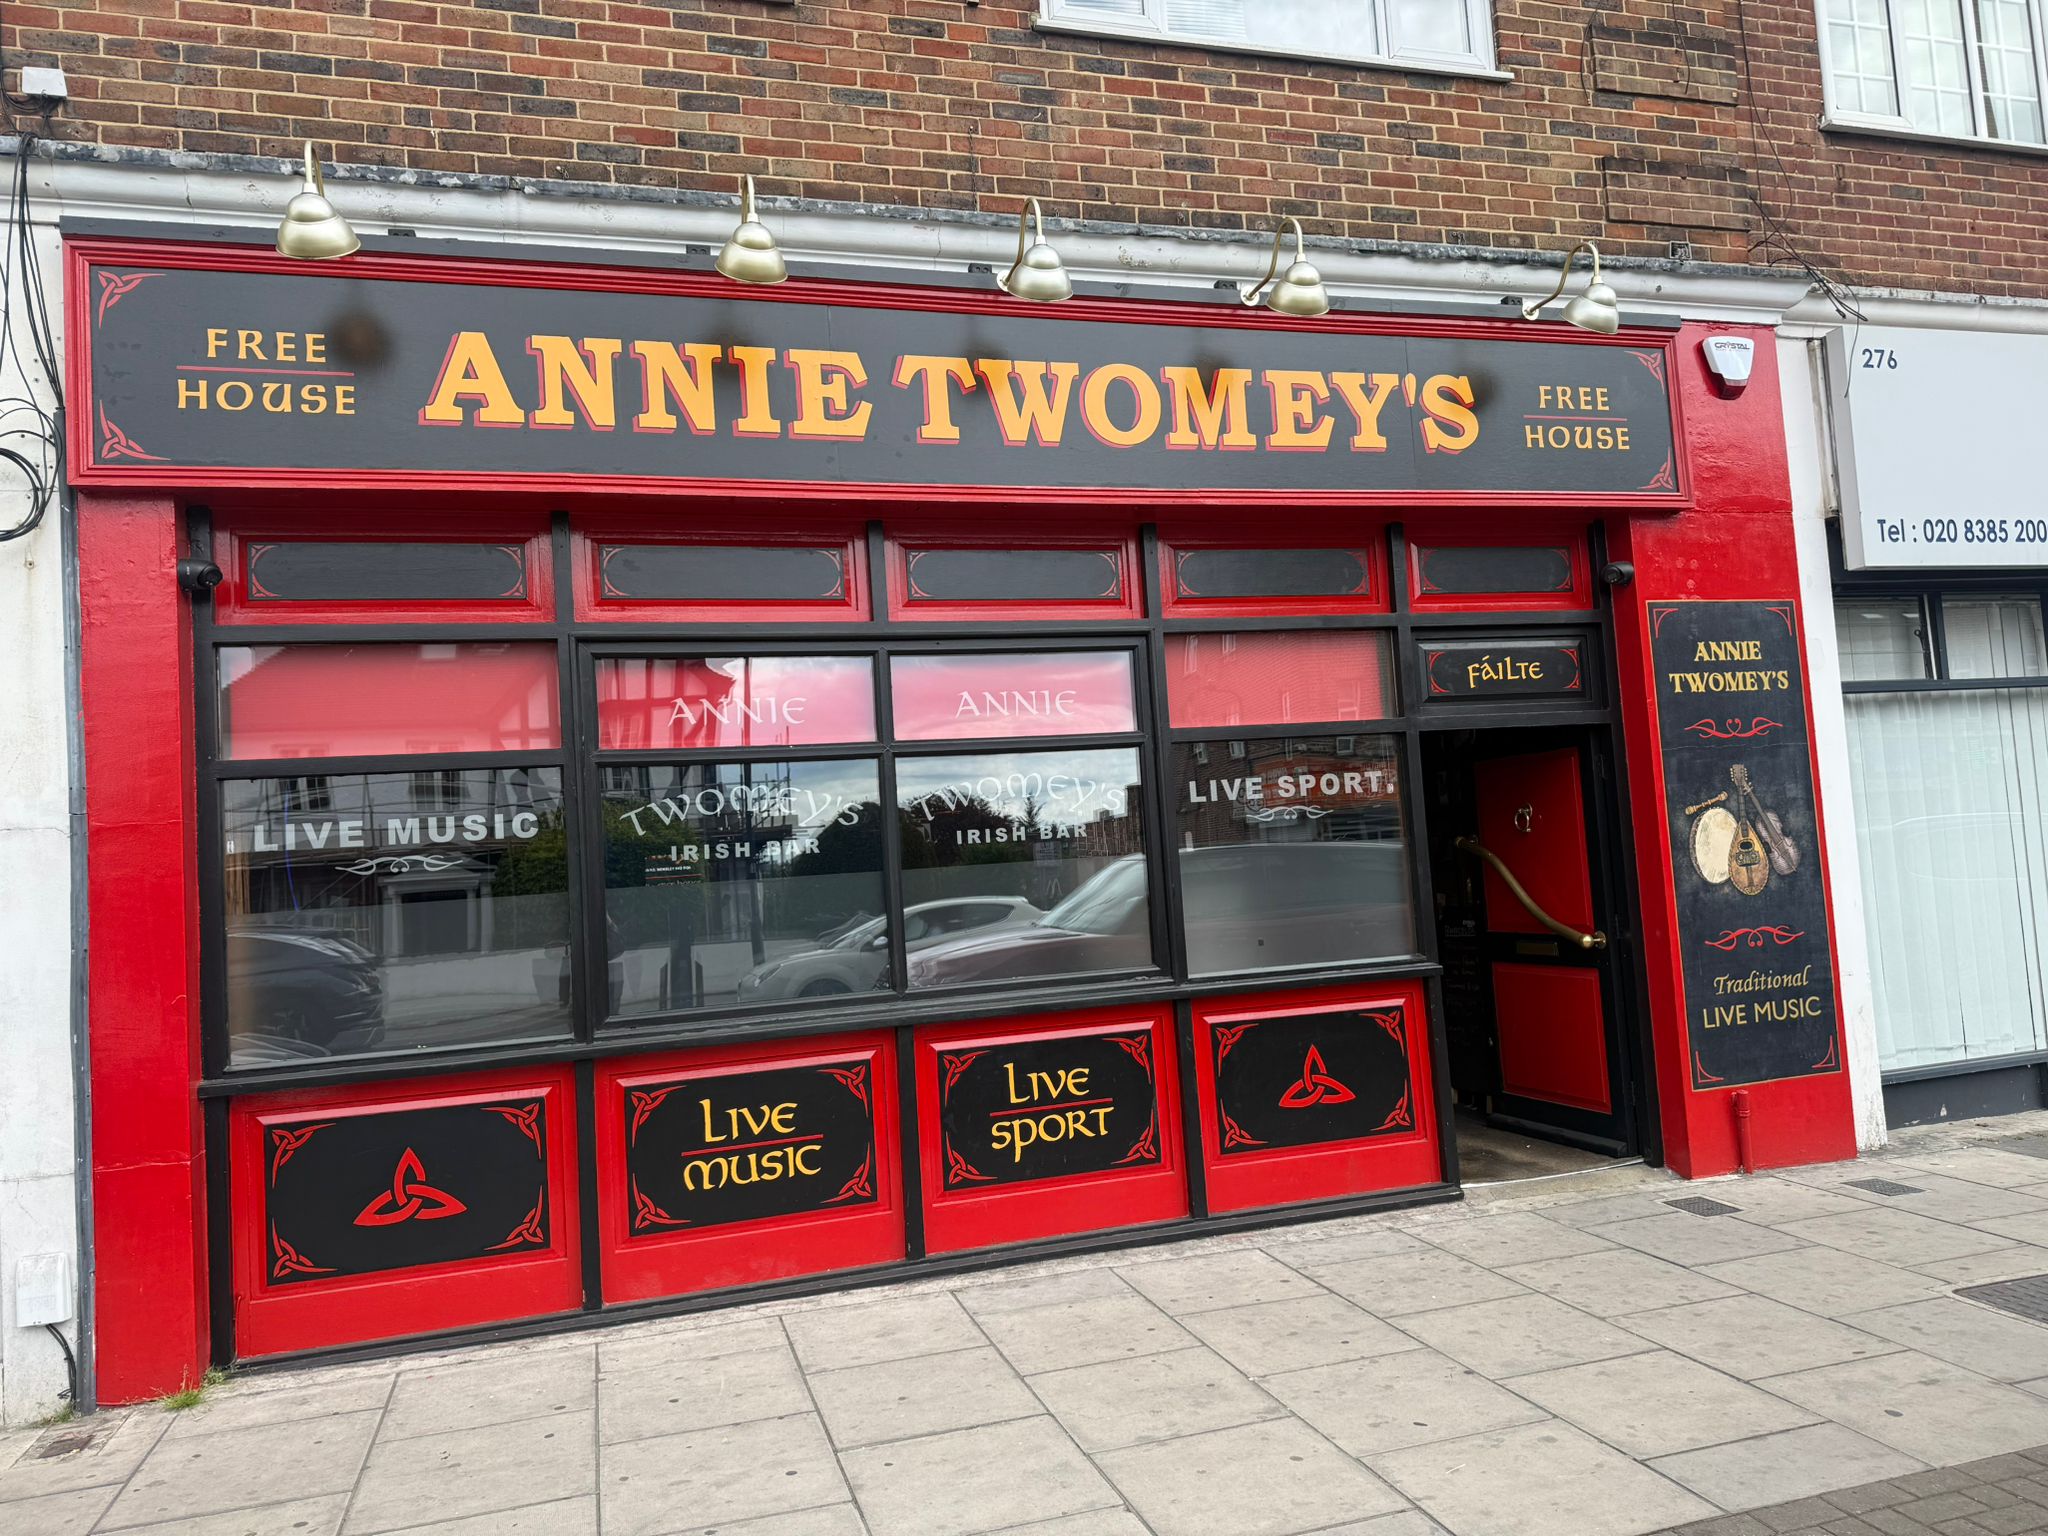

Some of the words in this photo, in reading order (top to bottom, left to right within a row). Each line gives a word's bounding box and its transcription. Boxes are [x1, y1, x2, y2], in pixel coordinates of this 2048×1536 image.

[206, 328, 327, 363] FREE
[1714, 341, 1751, 350] CRYSTAL
[1861, 348, 1898, 370] 276
[176, 378, 356, 415] HOUSE
[418, 331, 873, 442] ANNIE
[891, 355, 1481, 455] TWOMEY'S
[1538, 385, 1610, 411] FREE
[1524, 424, 1631, 450] HOUSE
[1876, 518, 1906, 543] Tel
[1922, 518, 1958, 543] 020
[1963, 518, 2009, 543] 8385
[1693, 640, 1762, 662] ANNIE
[1668, 670, 1790, 693] TWOMEY'S
[667, 697, 808, 727] ANNIE
[955, 690, 1078, 719] ANNIE
[911, 772, 1125, 822] TWOMEY'S
[1188, 777, 1265, 803] LIVE
[619, 785, 864, 837] TWOMEY'S
[253, 819, 364, 852] LIVE
[386, 812, 540, 846] MUSIC
[956, 825, 1027, 846] IRISH
[1040, 823, 1088, 840] BAR
[670, 841, 751, 862] IRISH
[766, 838, 821, 856] BAR
[1713, 965, 1812, 995] Traditional
[1703, 1004, 1748, 1028] LIVE
[1754, 996, 1822, 1023] MUSIC
